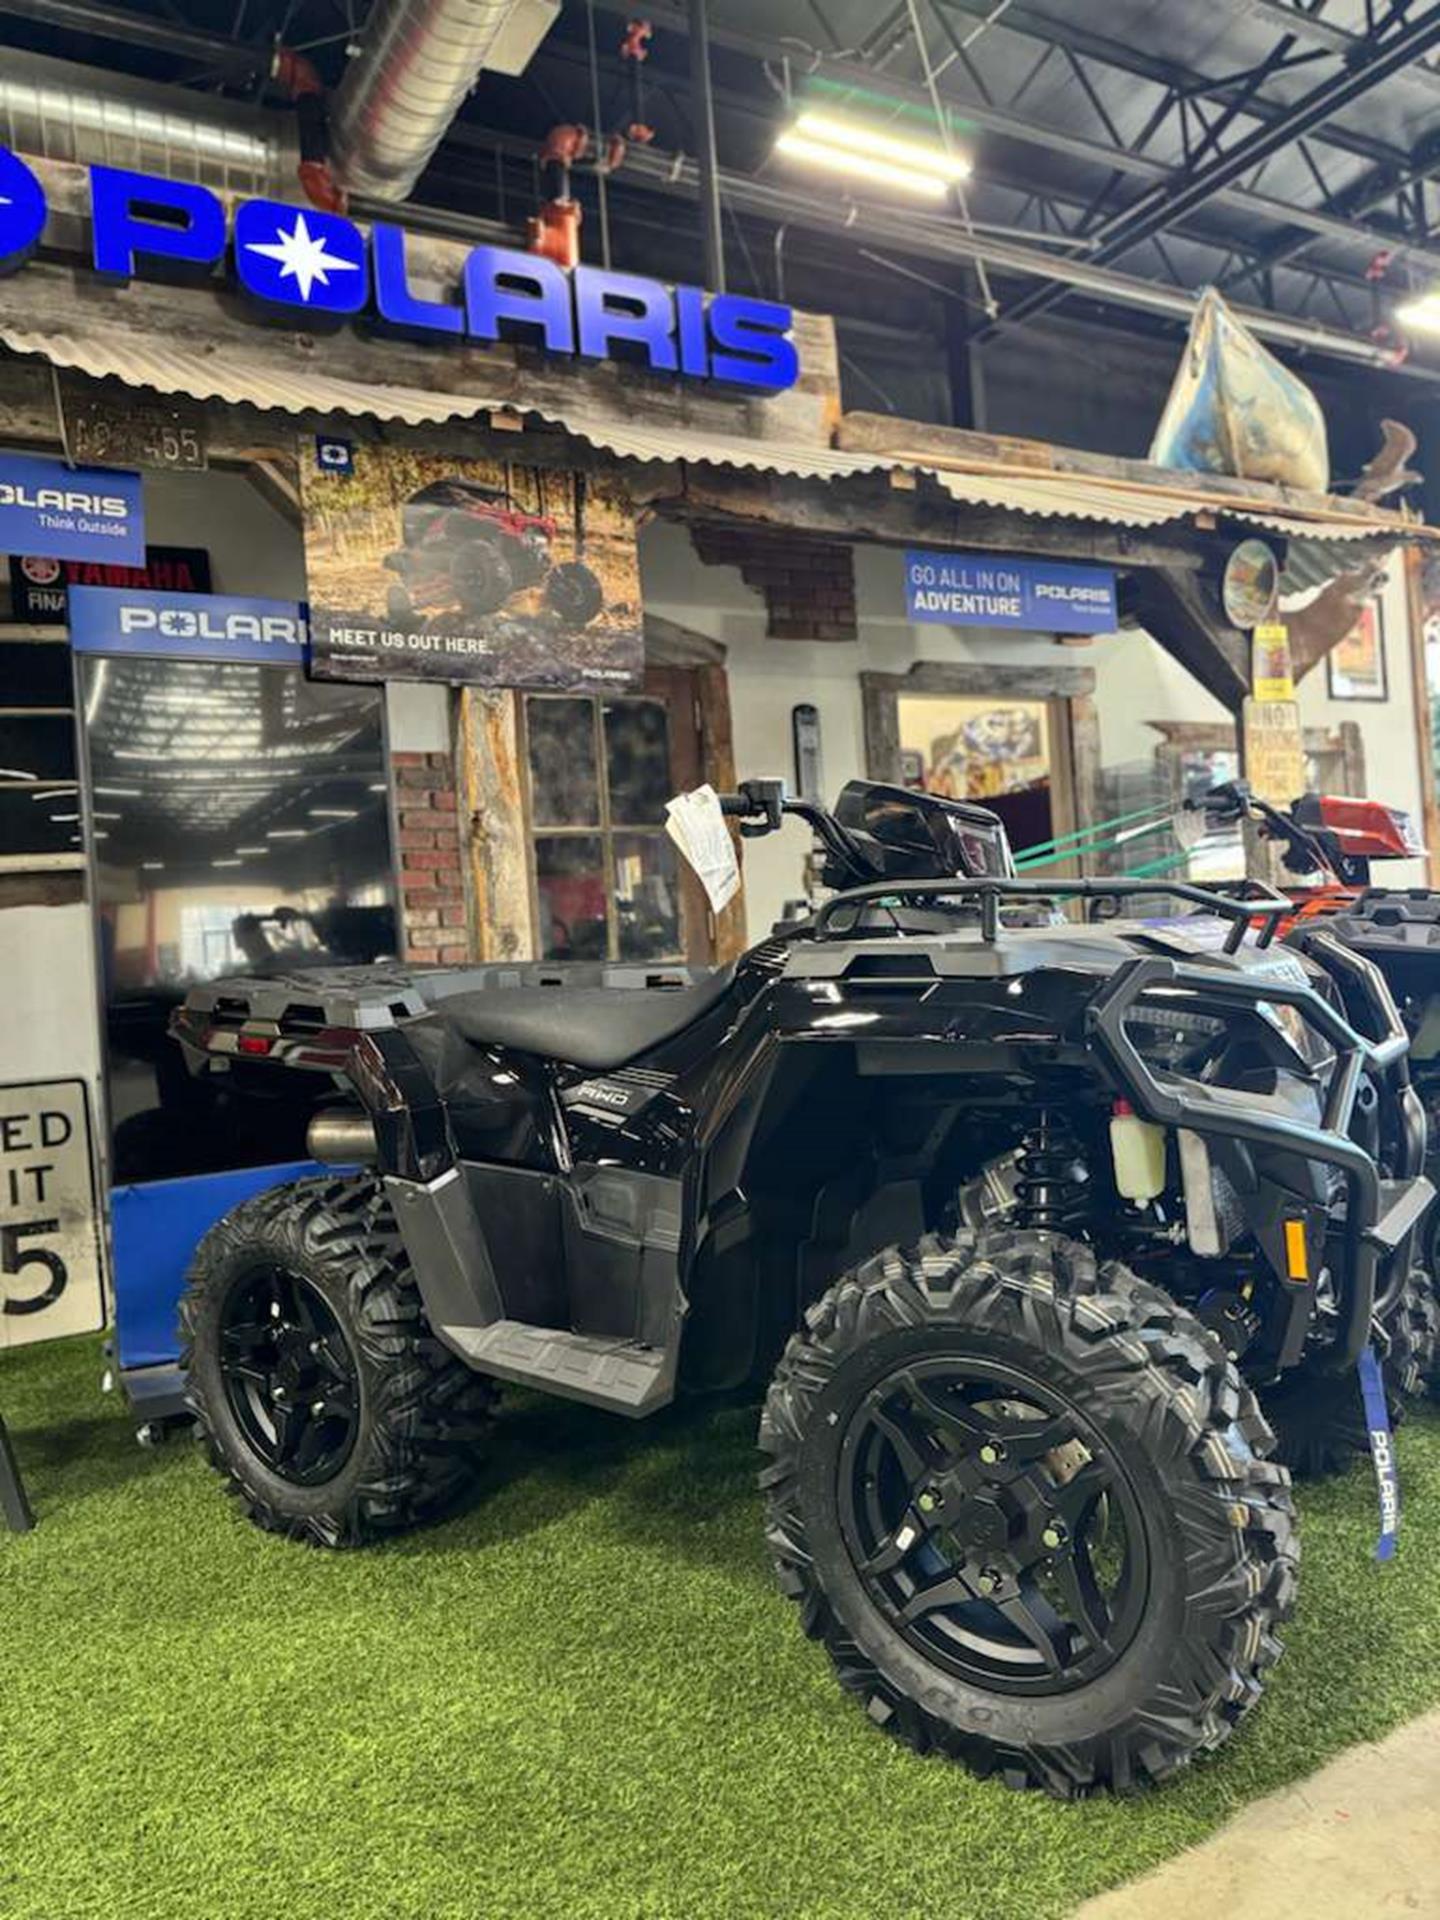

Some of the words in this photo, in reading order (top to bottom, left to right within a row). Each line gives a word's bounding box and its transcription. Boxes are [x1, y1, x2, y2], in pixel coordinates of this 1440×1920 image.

[90, 164, 799, 391] POLARIS
[39, 514, 76, 530] Think
[77, 517, 129, 537] Outside
[66, 560, 195, 590] YAMAHA
[911, 565, 936, 586] GO
[939, 568, 973, 590] ALL
[977, 571, 994, 591] IN
[997, 573, 1021, 593] ON
[914, 591, 1021, 616] ADVENTURE
[1034, 584, 1111, 602] POLARIS
[329, 628, 377, 645] MEET
[381, 632, 405, 648] US
[408, 634, 443, 650] OUT
[446, 637, 494, 654] HERE.
[0, 1111, 72, 1150] ED
[9, 1165, 54, 1206] IT
[0, 1219, 68, 1316] 5
[1370, 1429, 1396, 1535] POLARIS
